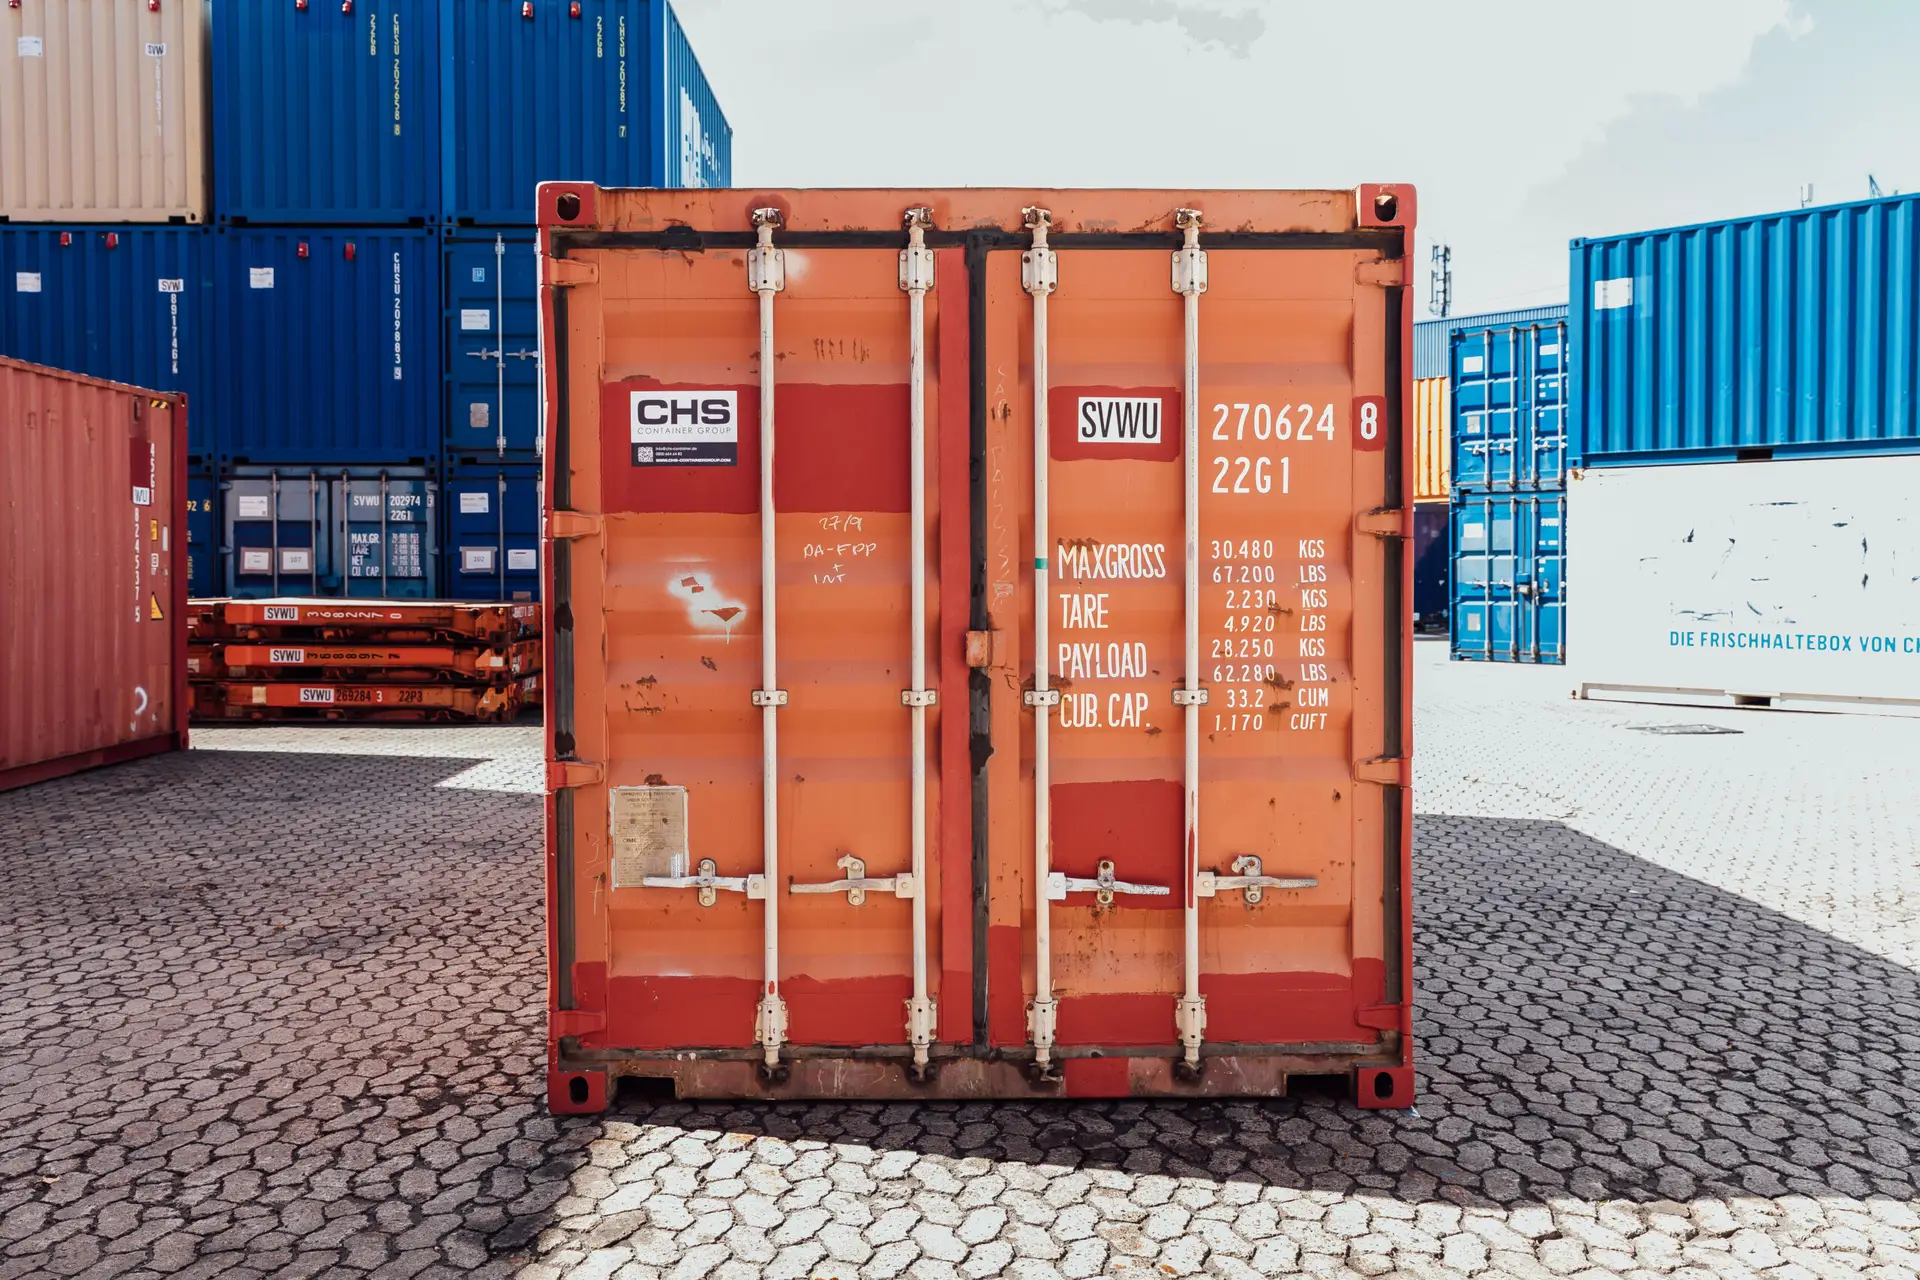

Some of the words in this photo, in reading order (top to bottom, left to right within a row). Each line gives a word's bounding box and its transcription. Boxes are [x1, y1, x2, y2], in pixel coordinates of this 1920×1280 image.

[637, 399, 731, 425] CHS
[1081, 401, 1158, 440] SVWU
[1211, 403, 1335, 441] 270624
[1360, 402, 1378, 440] 8
[637, 427, 693, 435] CONTAINER
[697, 426, 731, 435] GROUP
[1211, 456, 1290, 494] 22G1
[353, 495, 380, 507] SVWU
[389, 495, 421, 507] 202974
[390, 510, 411, 521] 22G1
[352, 544, 370, 555] TARE
[351, 555, 364, 566] NET
[1058, 543, 1167, 580] MAXGROSS
[1299, 539, 1325, 559] KGS
[1300, 565, 1327, 583] LBS
[267, 607, 296, 619] SVWU
[306, 611, 384, 619] 368227
[1059, 593, 1109, 629] TARE
[1301, 589, 1328, 609] KGS
[1300, 615, 1327, 632] LBS
[1669, 631, 1695, 647] DIE
[1700, 631, 1852, 652] FRISCHHALTEBOX
[1859, 636, 1897, 653] VON
[273, 649, 302, 662] SVWU
[1058, 642, 1148, 679] PAYLOAD
[1299, 638, 1325, 657] KGS
[1300, 663, 1328, 682] LBS
[303, 689, 332, 701] SVWU
[376, 690, 383, 702] 3
[1060, 693, 1102, 728] CUB.
[1108, 692, 1150, 728] CAP.
[1226, 688, 1264, 709] 33.2
[1298, 688, 1329, 707] CUM
[1290, 713, 1328, 731] CUFT
